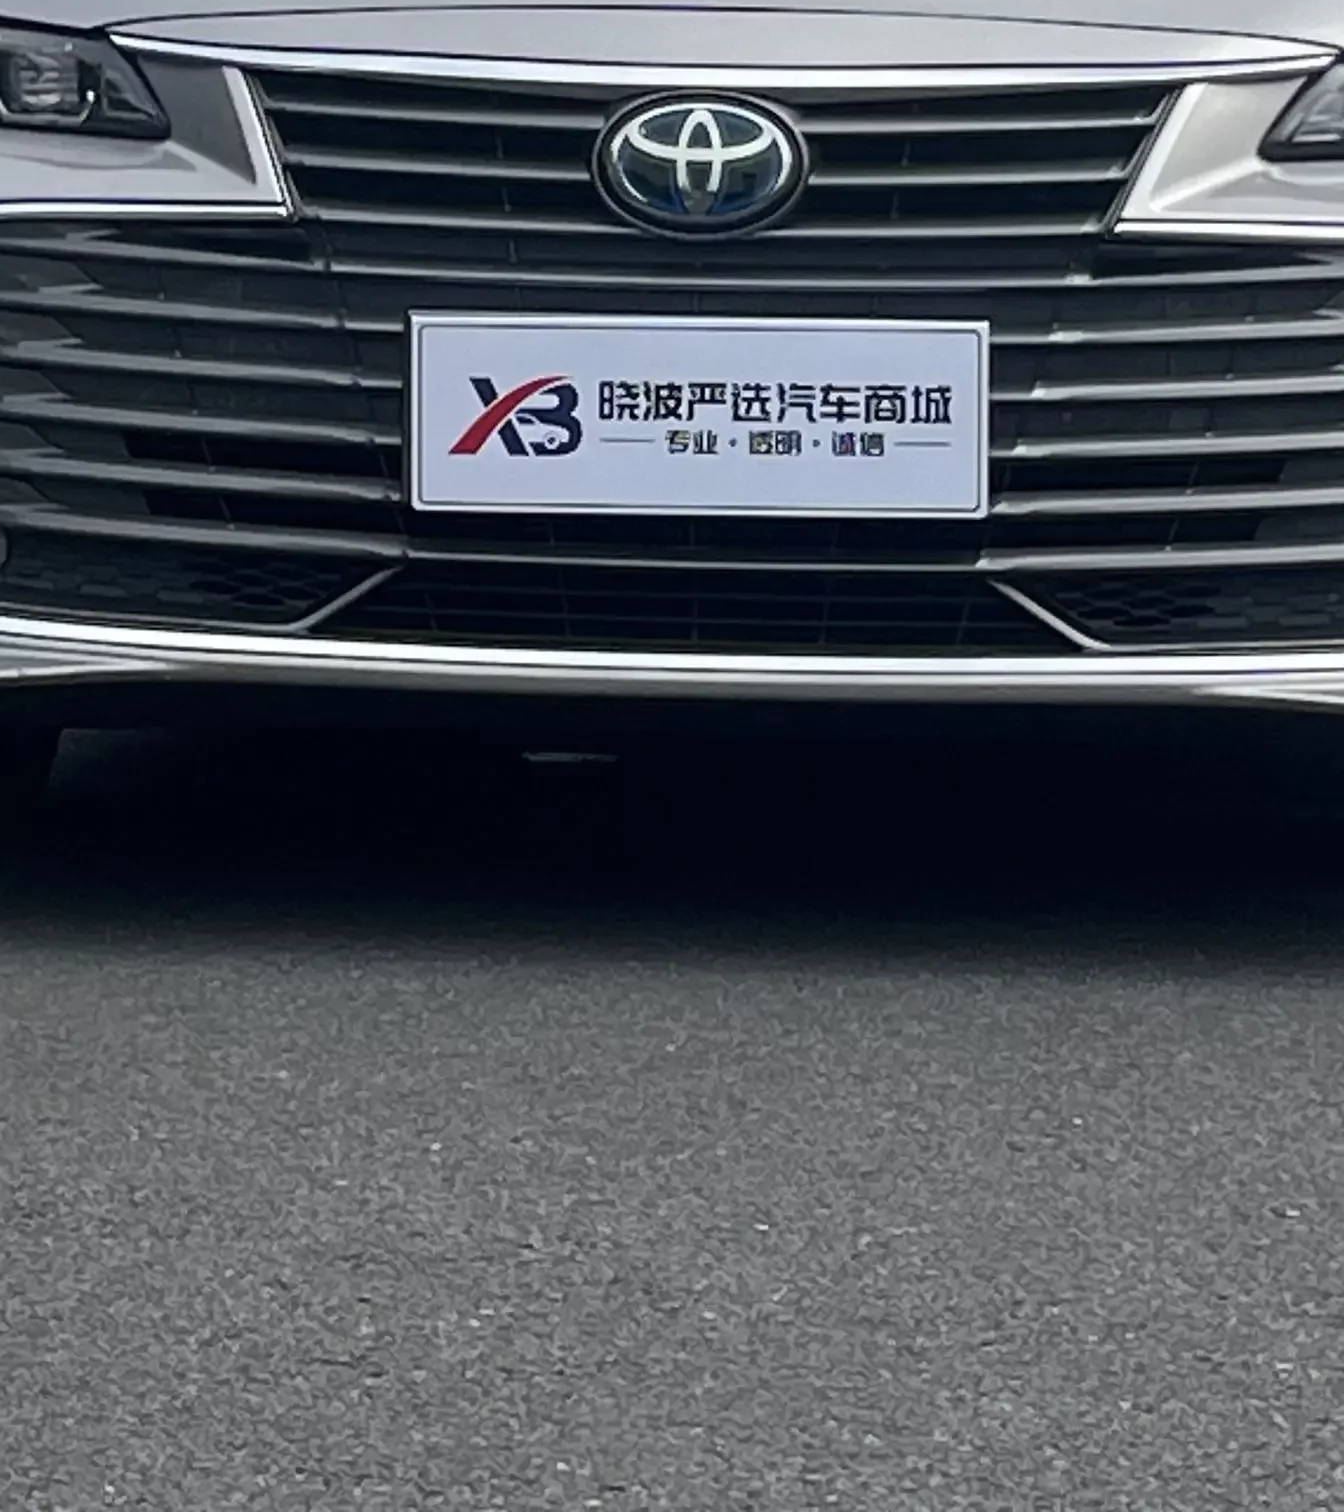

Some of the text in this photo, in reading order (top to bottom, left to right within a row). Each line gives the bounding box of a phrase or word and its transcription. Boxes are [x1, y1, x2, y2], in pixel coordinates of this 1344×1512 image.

[597, 379, 953, 425] 晓波严选汽车商城
